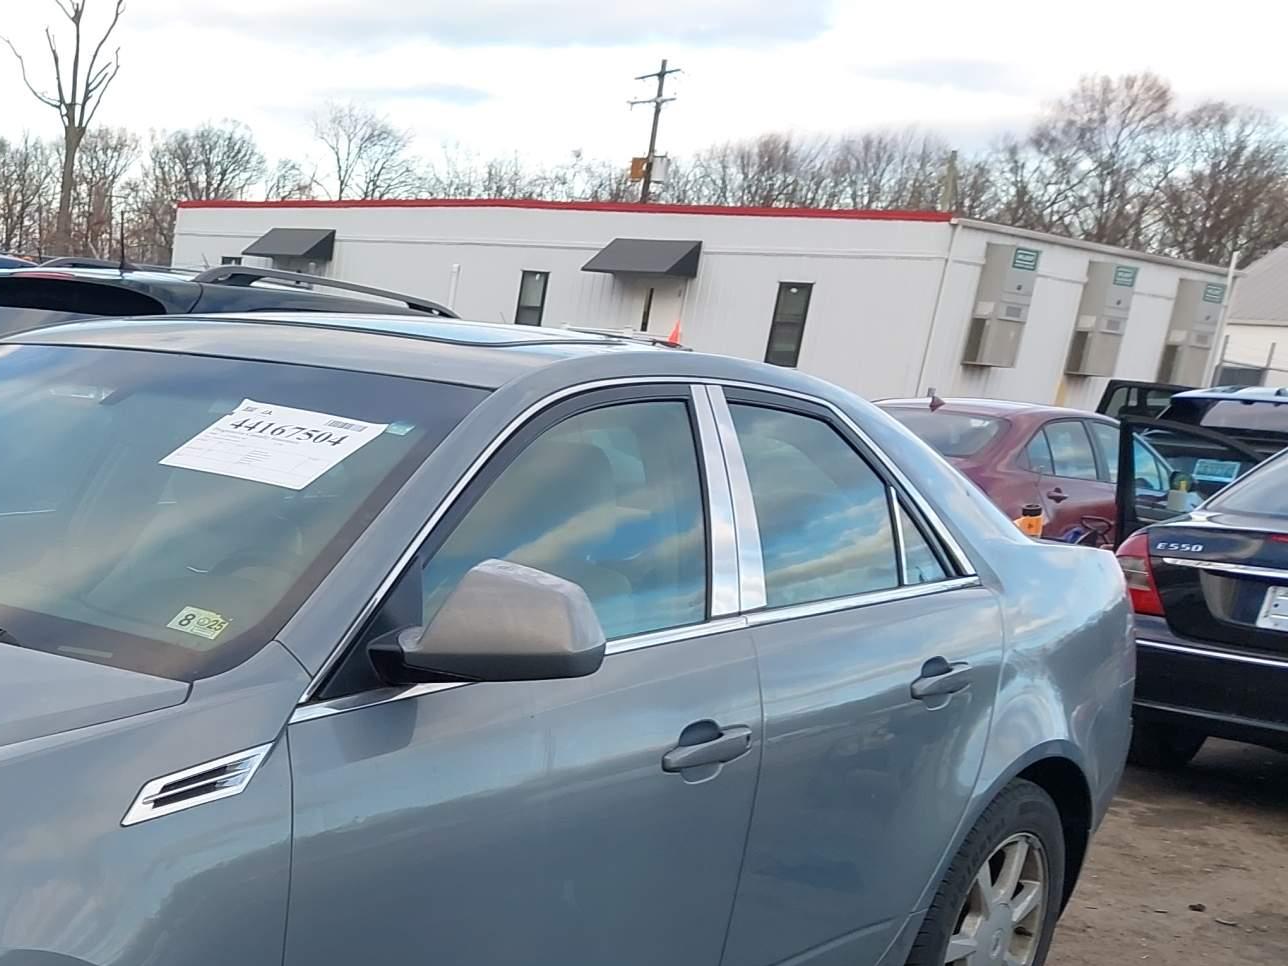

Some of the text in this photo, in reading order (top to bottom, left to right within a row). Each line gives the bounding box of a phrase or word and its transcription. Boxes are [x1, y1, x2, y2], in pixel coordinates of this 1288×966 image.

[230, 418, 349, 446] 44167504
[1156, 542, 1204, 552] E550
[178, 613, 226, 631] 8 25
